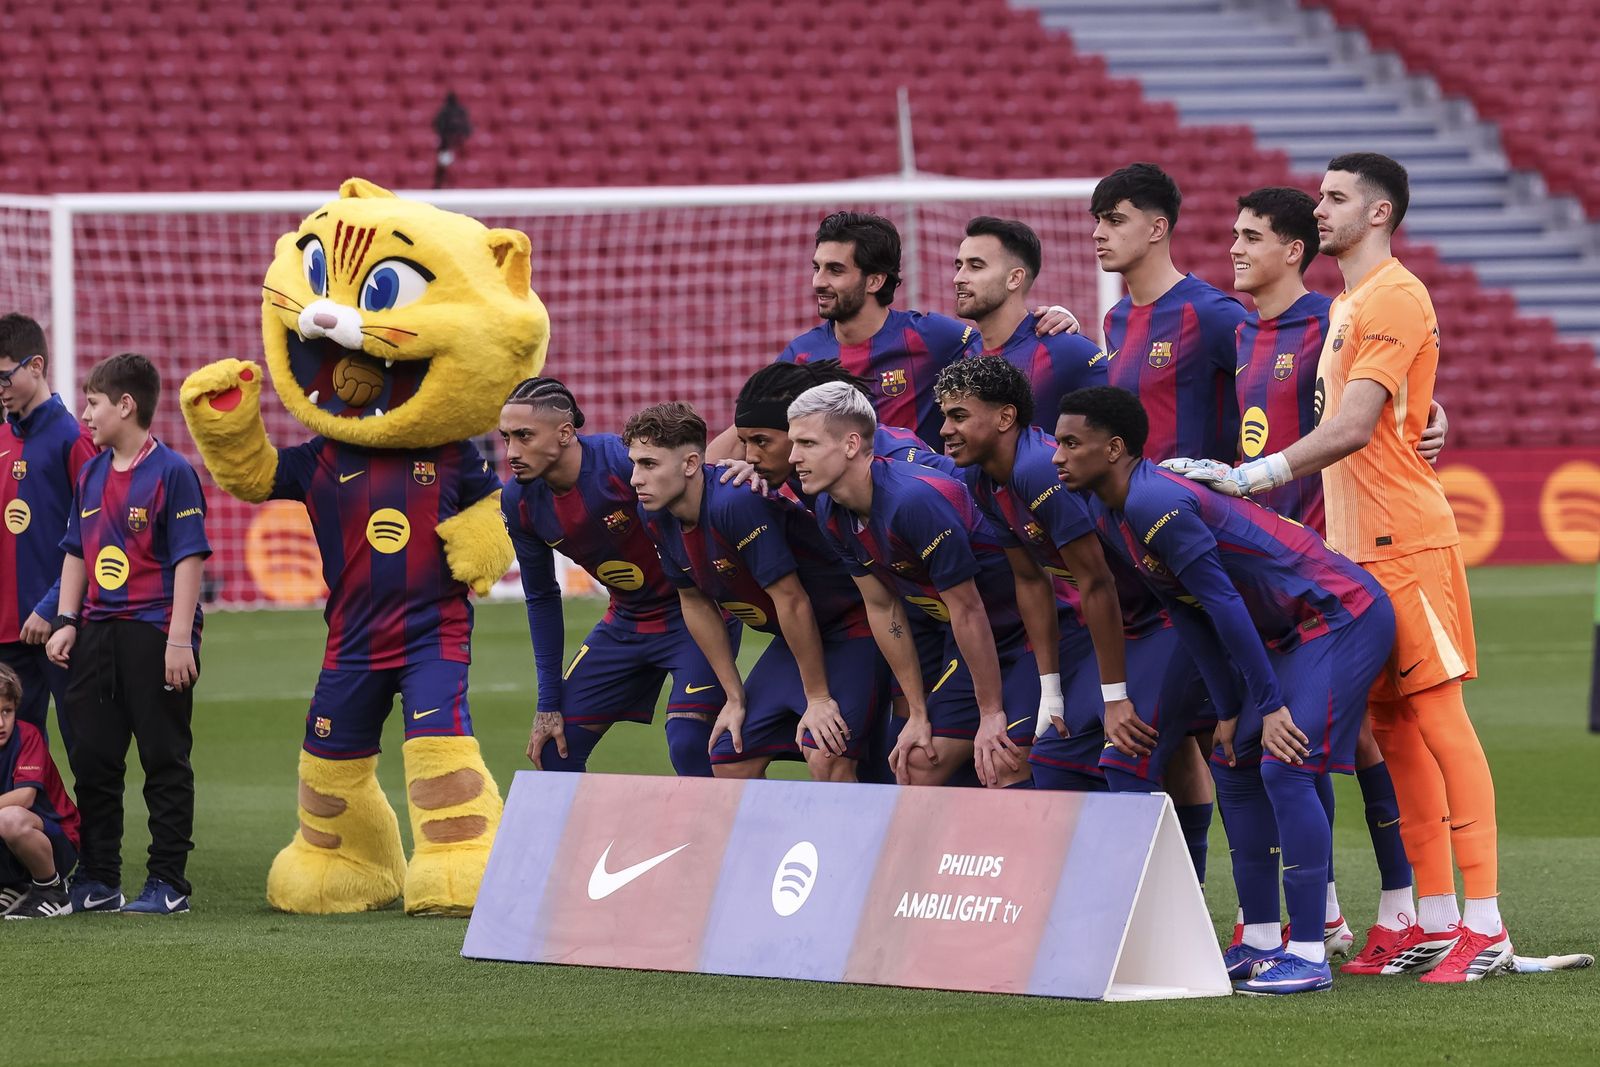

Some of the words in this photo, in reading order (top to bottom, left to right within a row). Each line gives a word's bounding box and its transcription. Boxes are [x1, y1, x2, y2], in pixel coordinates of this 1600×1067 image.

[1170, 509, 1179, 517] tv
[938, 853, 1004, 878] PHILIPS
[893, 891, 1002, 923] AMBILIGHT
[1003, 899, 1023, 924] tv
